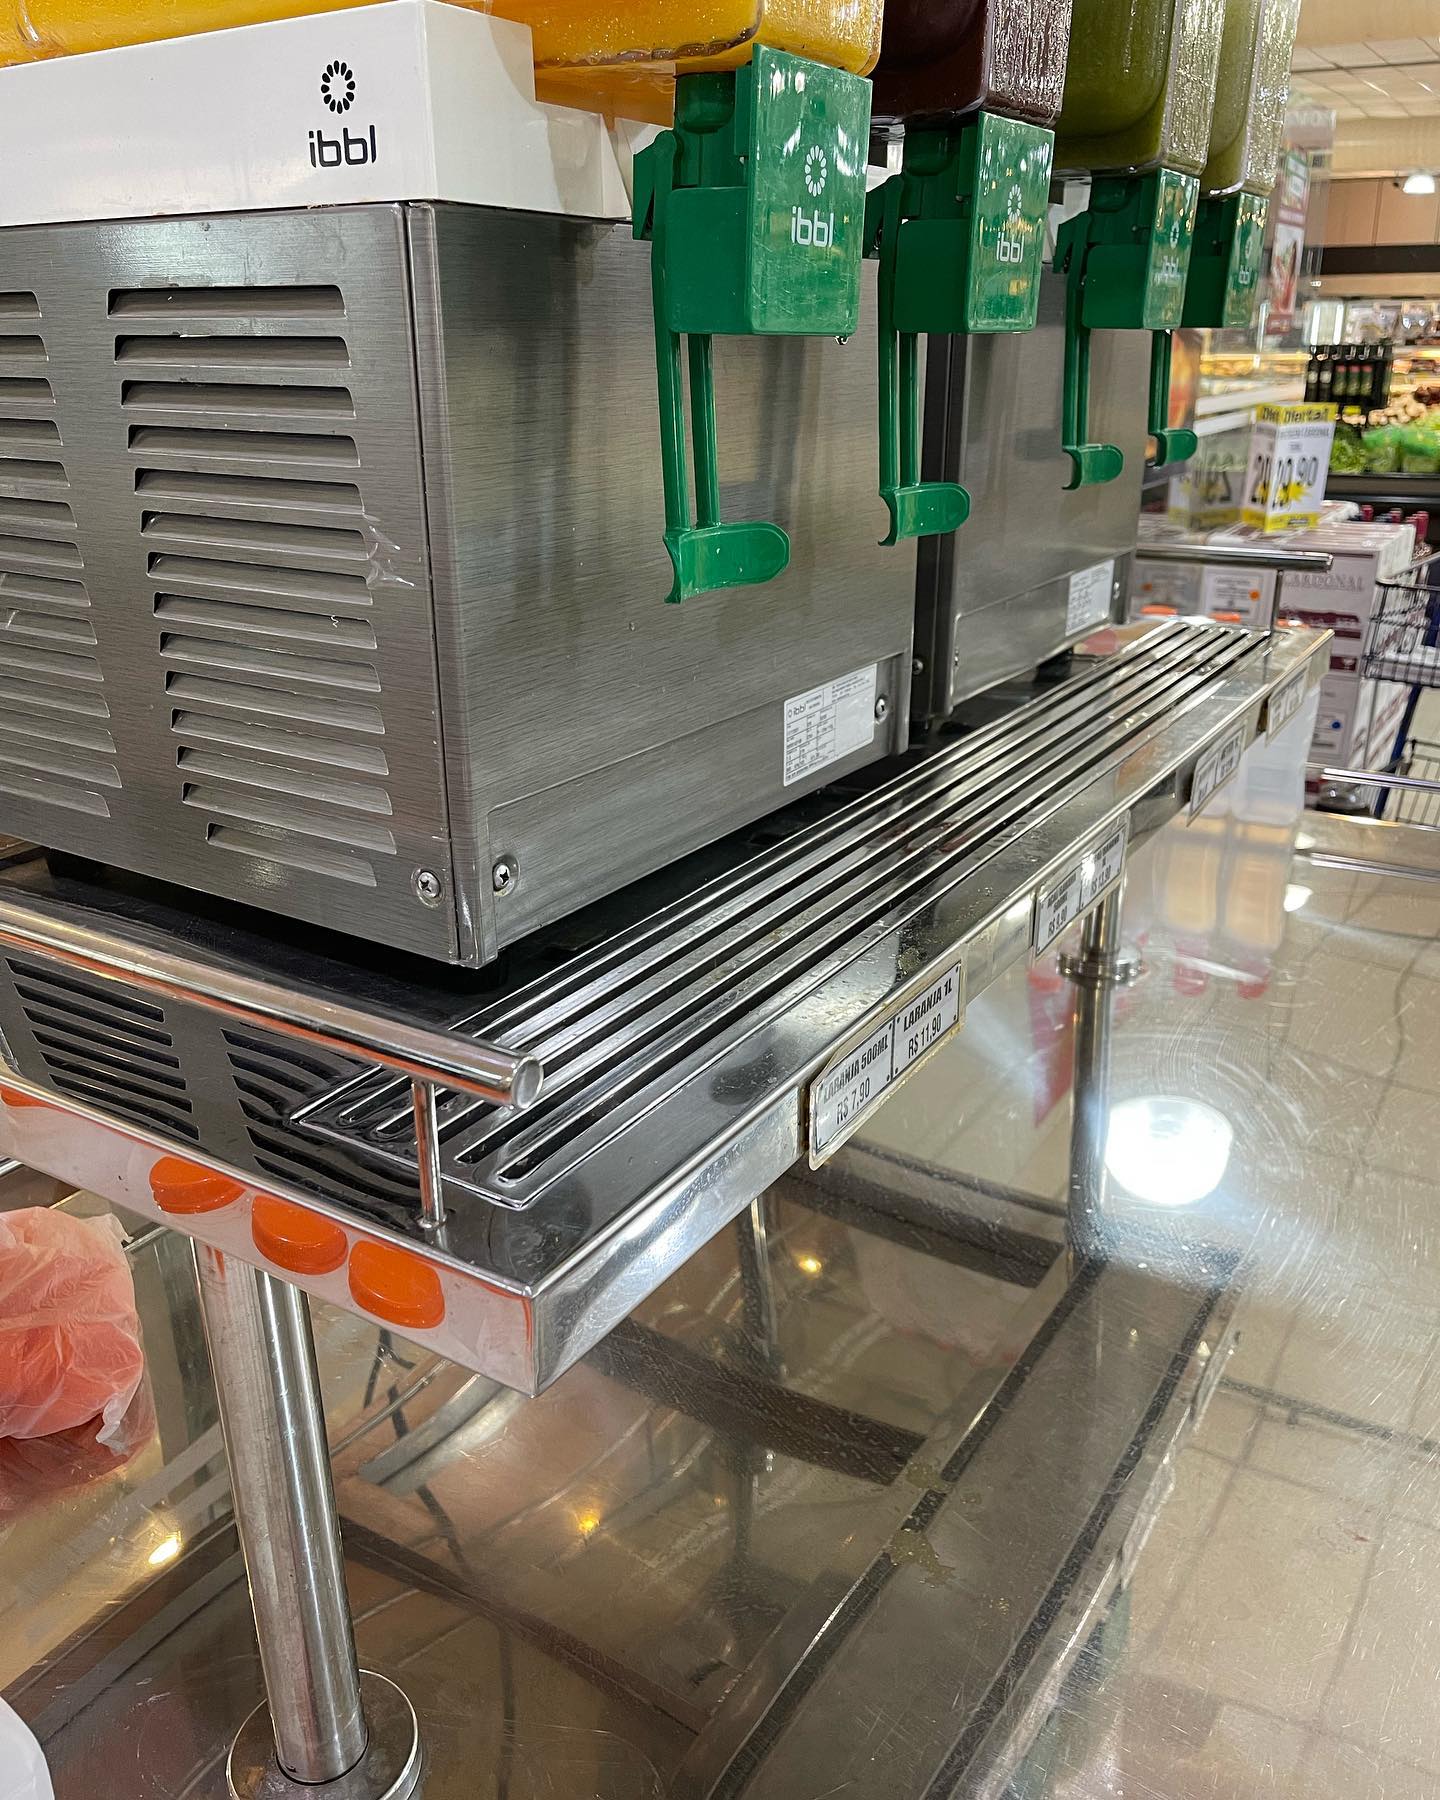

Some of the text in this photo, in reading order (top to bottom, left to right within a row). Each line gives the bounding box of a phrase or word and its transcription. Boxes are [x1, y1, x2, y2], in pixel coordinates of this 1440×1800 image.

[308, 124, 377, 168] ibbl
[791, 205, 835, 248] ibbl
[996, 230, 1025, 264] ibbl
[1047, 917, 1056, 939] R$
[904, 977, 953, 1033] LARANJA 1L
[908, 1012, 942, 1060] R$ 11,90
[823, 1033, 889, 1105] LARANJA 500ML
[836, 1077, 871, 1125] R$ 7,90
